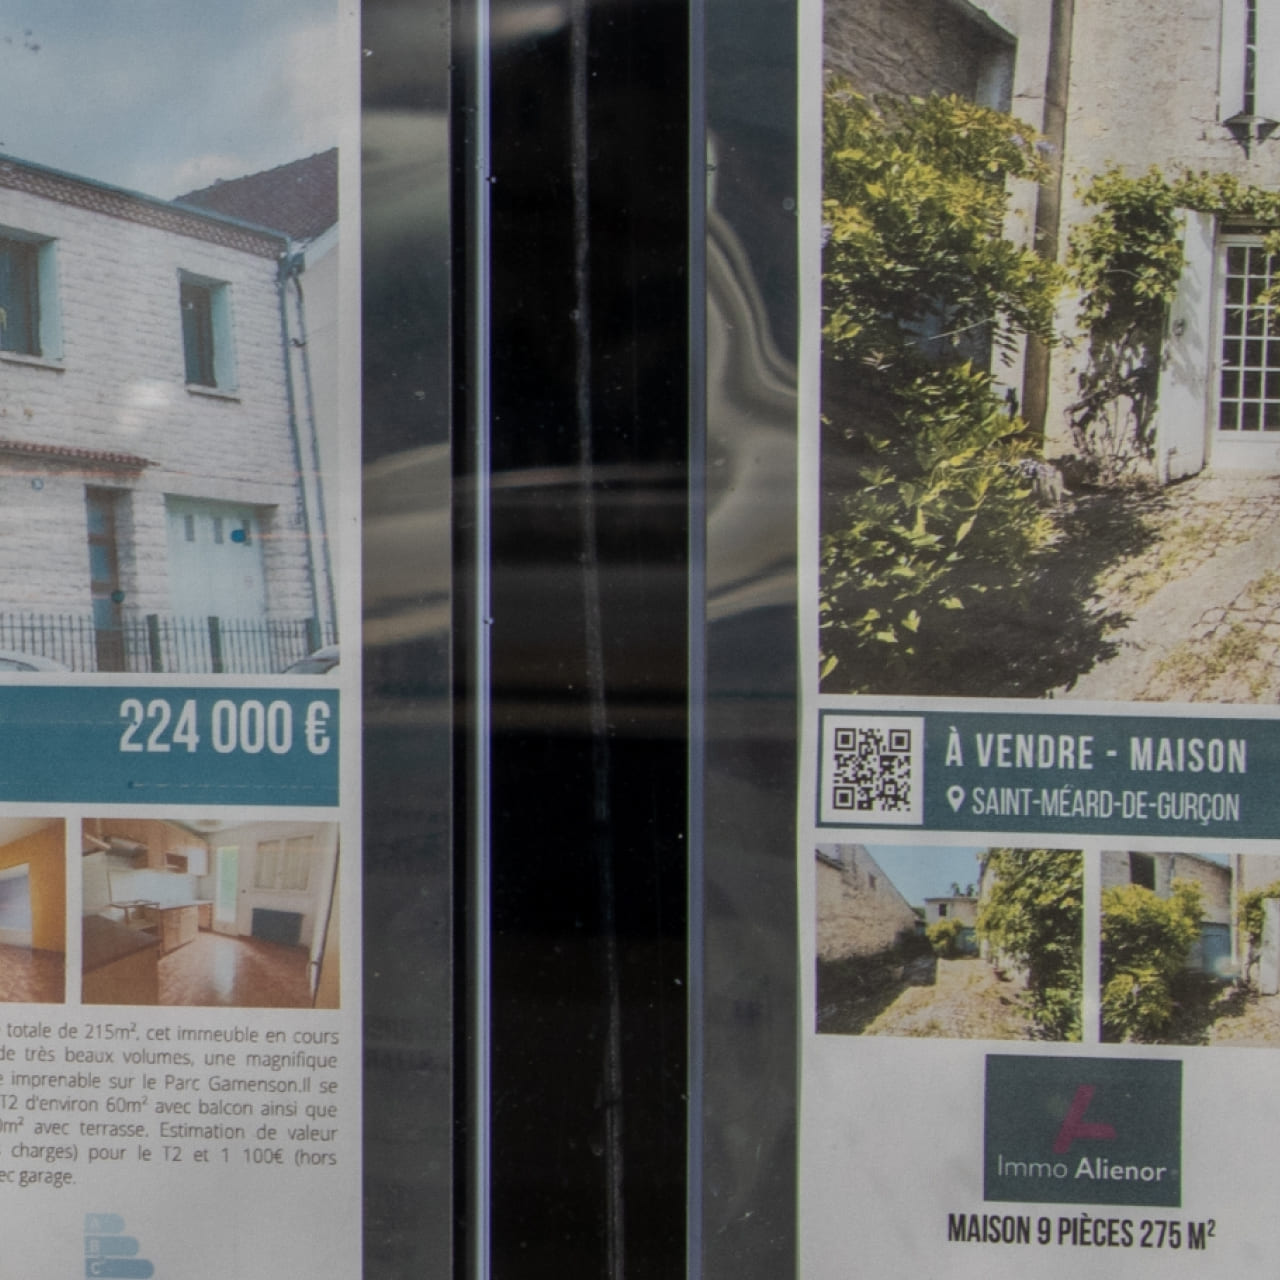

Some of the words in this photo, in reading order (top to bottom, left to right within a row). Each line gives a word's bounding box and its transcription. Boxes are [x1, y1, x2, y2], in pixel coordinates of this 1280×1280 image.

[119, 698, 200, 753] 224
[211, 699, 293, 754] 000
[304, 700, 331, 755] €
[945, 725, 964, 767] À
[975, 732, 1094, 770] VENDRE
[1130, 736, 1247, 774] MAISON
[971, 783, 1240, 826] SAINT-MÉARD-DE-GURÇON
[24, 1044, 56, 1063] très
[64, 1045, 115, 1064] beaux
[122, 1047, 195, 1068] volumes,
[203, 1053, 237, 1068] une
[245, 1049, 339, 1073] magnifique
[997, 1153, 1068, 1179] Immo
[1074, 1156, 1168, 1182] Alienor
[947, 1212, 1031, 1245] MAISON
[1037, 1216, 1052, 1246] 9
[1057, 1212, 1134, 1248] PIÈCES
[1139, 1219, 1182, 1250] 275
